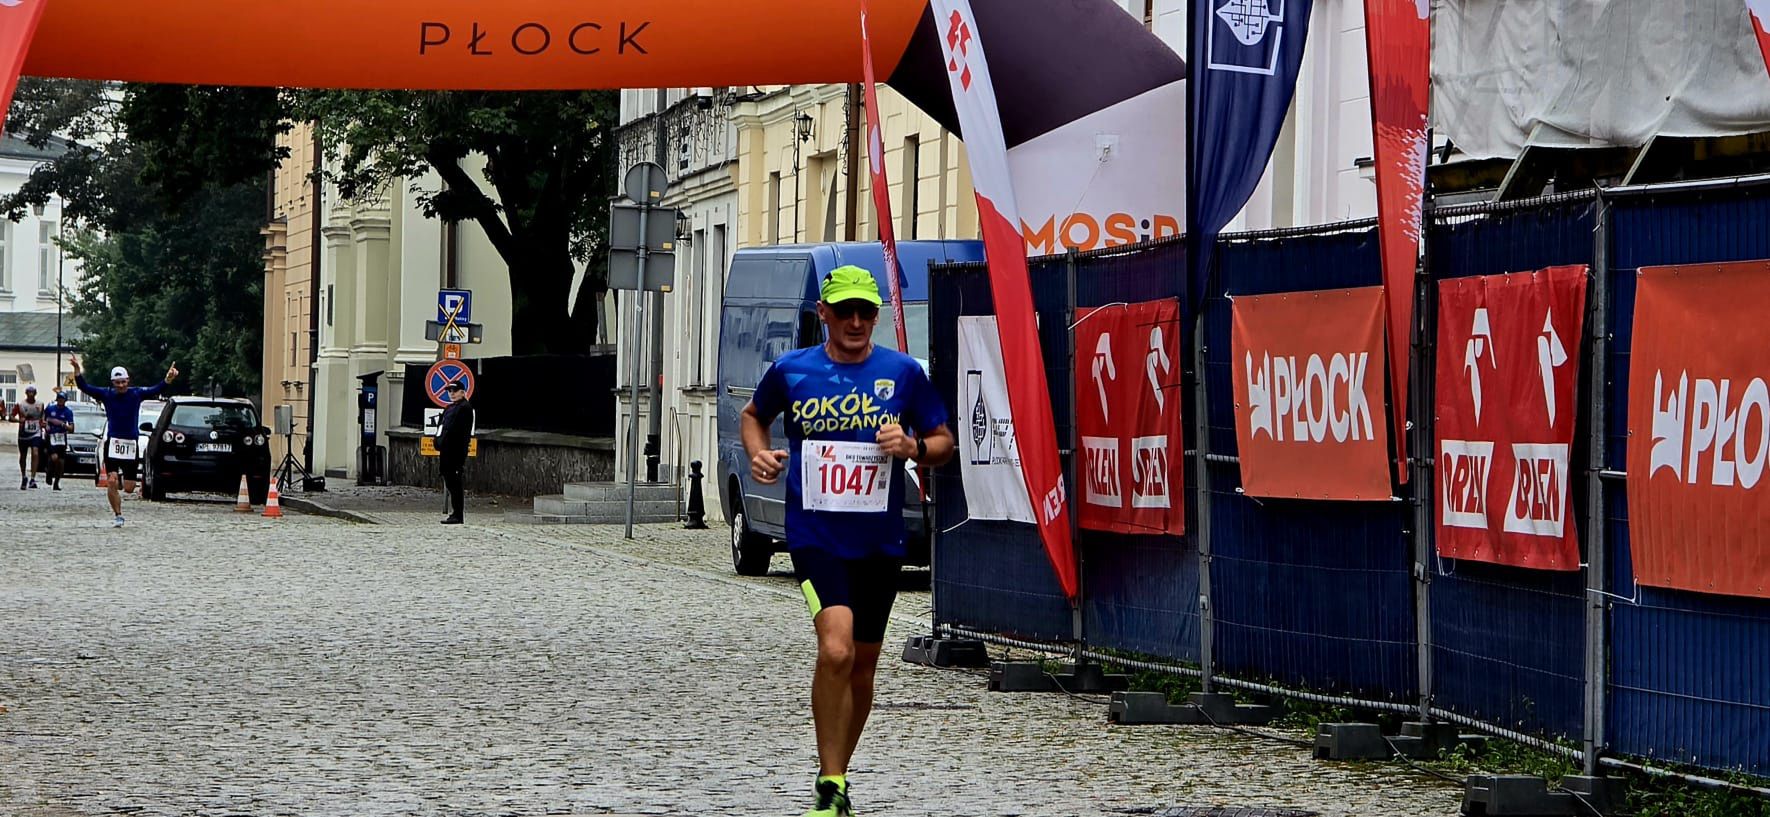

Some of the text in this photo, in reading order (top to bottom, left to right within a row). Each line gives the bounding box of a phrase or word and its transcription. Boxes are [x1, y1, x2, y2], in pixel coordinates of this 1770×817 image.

[419, 20, 651, 56] PŁOCK
[792, 387, 881, 423] SOKÓŁ
[1273, 351, 1374, 443] PŁOCK
[801, 408, 900, 436] BODZANÓW
[1688, 377, 1770, 490] PŁO
[115, 444, 130, 455] 901
[818, 463, 879, 496] 1047
